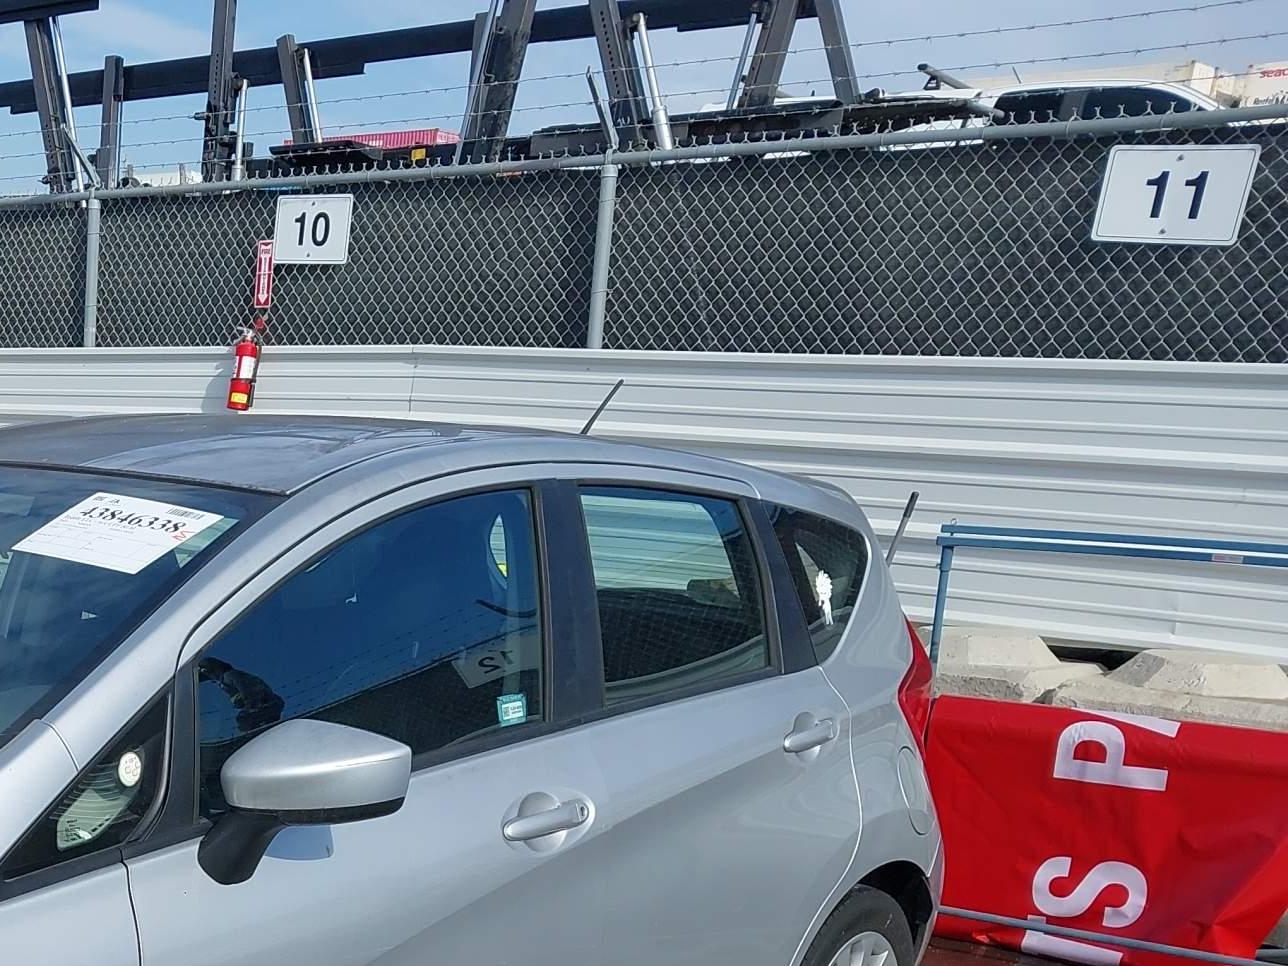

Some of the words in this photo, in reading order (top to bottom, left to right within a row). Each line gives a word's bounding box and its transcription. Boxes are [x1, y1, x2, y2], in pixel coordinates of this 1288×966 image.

[1145, 170, 1210, 220] 11
[294, 211, 331, 247] 10
[80, 506, 187, 533] 43846338
